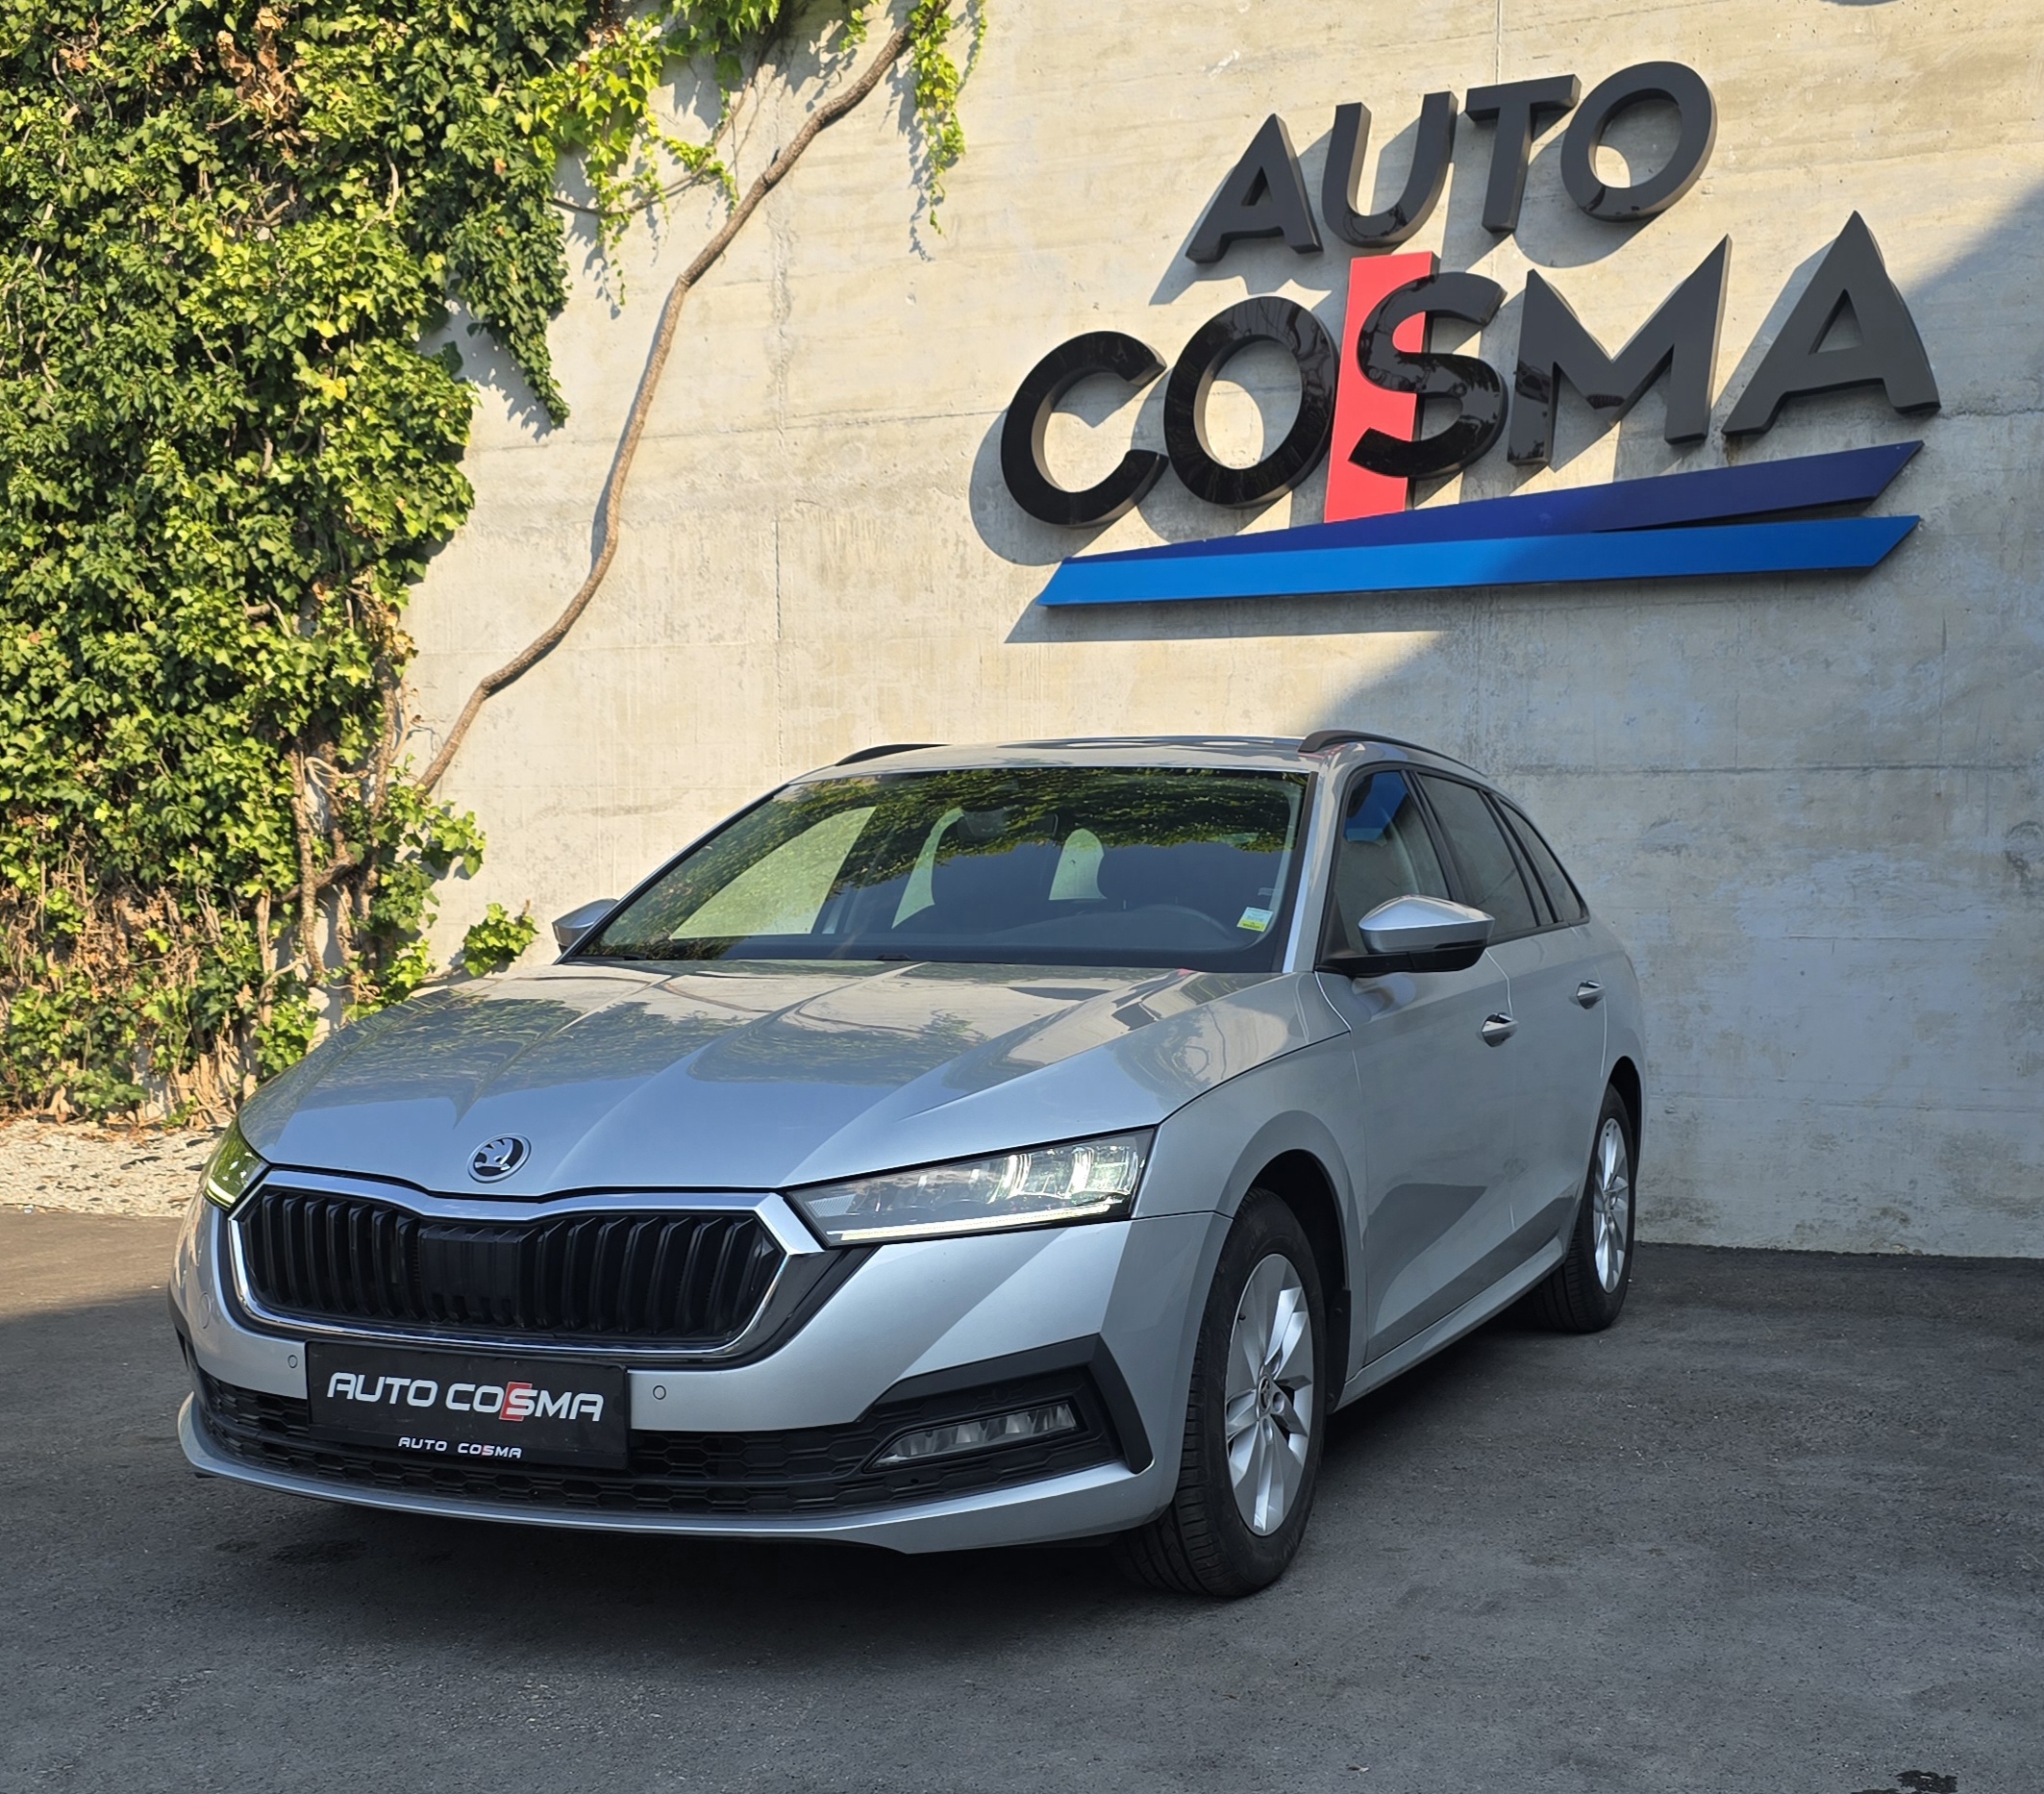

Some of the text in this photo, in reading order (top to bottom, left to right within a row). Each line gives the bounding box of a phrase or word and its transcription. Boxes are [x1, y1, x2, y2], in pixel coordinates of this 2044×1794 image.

[1185, 61, 1717, 263] AUTO
[1001, 211, 1941, 528] COSMA
[327, 1372, 604, 1421] AUTO COSMA
[398, 1437, 522, 1458] AUTO COSMA
